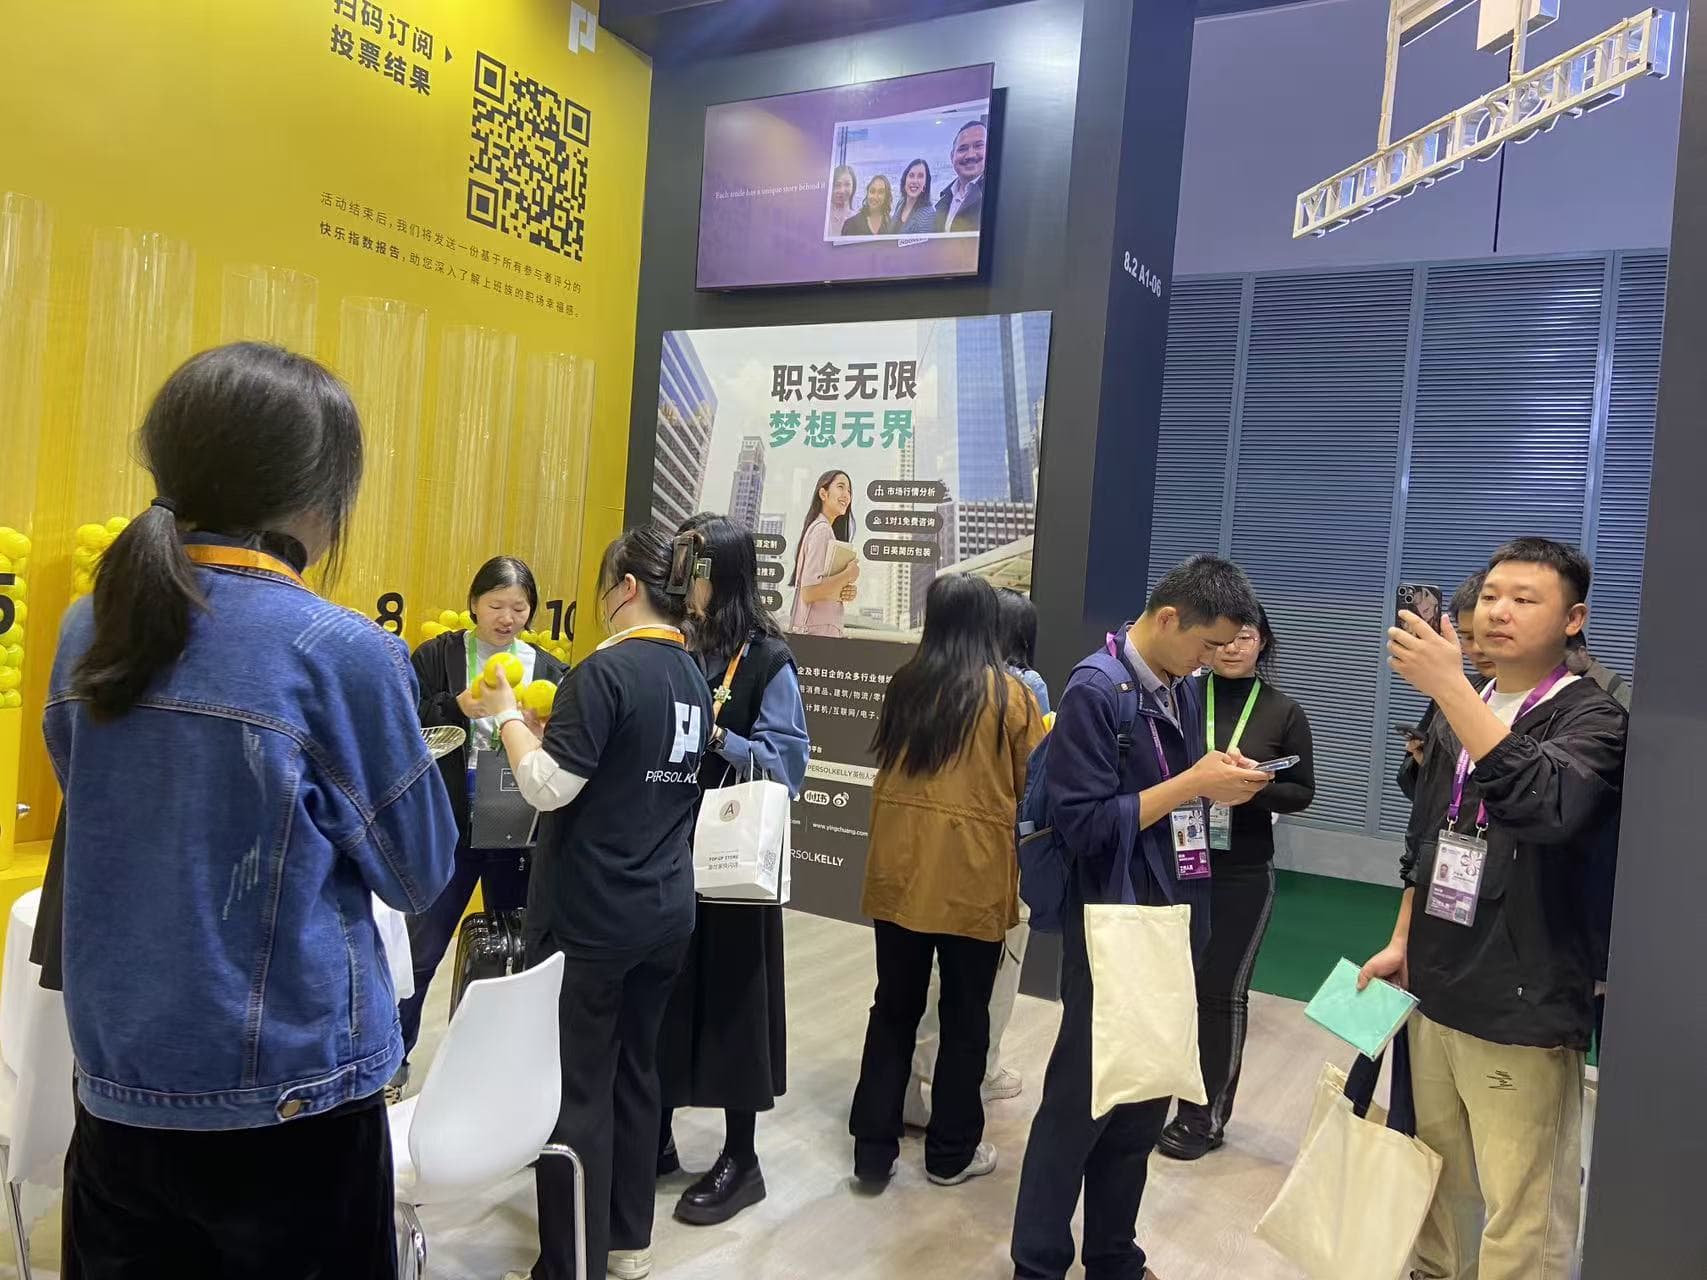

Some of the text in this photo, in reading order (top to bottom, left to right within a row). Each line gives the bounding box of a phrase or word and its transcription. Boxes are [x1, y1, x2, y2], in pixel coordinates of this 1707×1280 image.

[334, 0, 433, 60] 扫码订阅
[330, 24, 431, 96] 投票结果
[762, 188, 782, 197] unique
[782, 185, 797, 194] story
[799, 182, 820, 191] behind
[1124, 250, 1162, 298] 8.2 A1-06
[771, 360, 918, 401] 职途无限
[769, 409, 913, 449] 梦想无界
[887, 486, 936, 497] 市场行情分析
[884, 516, 936, 527] 1对1免费咨询
[882, 545, 931, 557] 日英简历包装
[375, 592, 404, 637] 8
[812, 823, 869, 837] www.yingchuang.com
